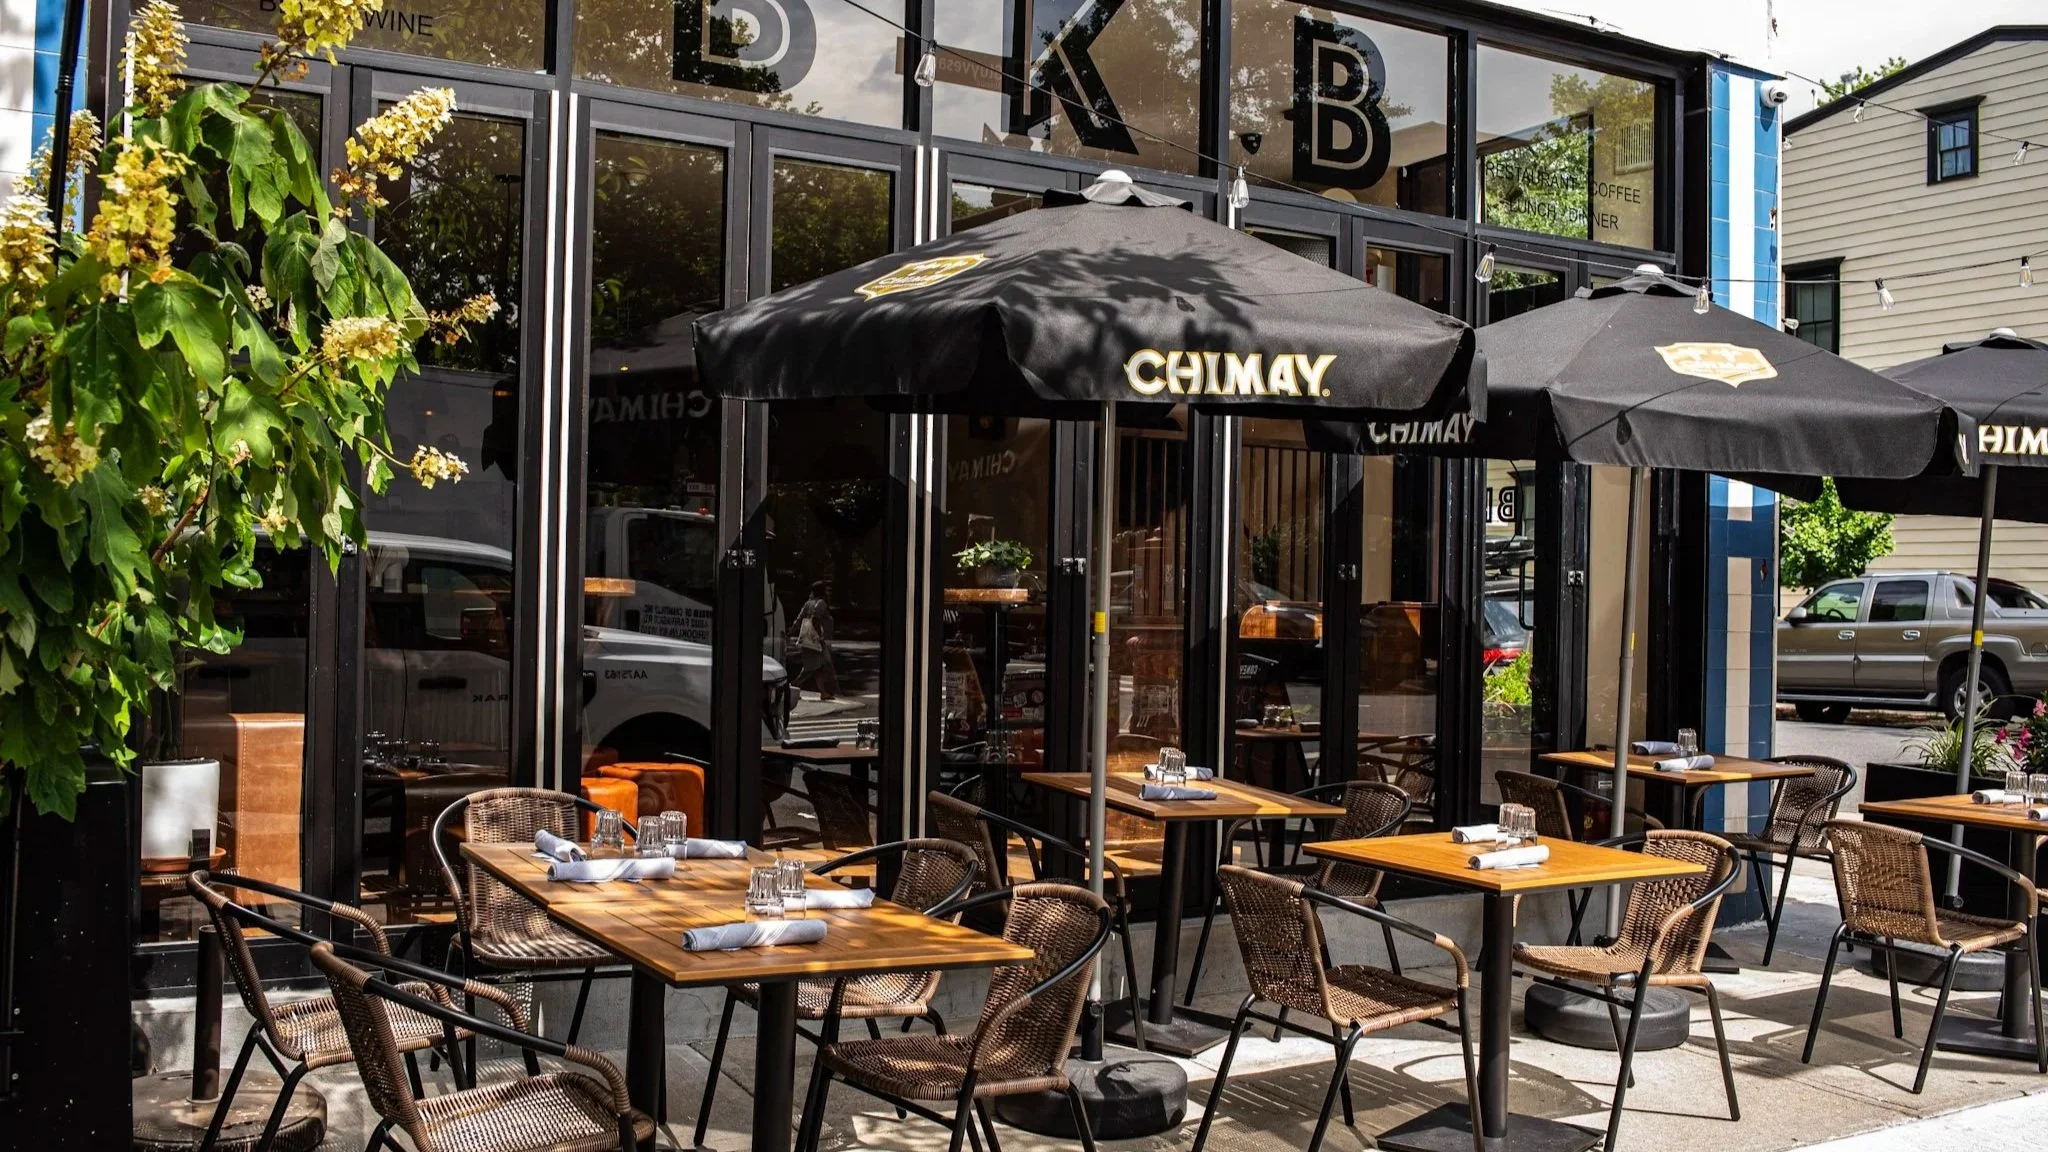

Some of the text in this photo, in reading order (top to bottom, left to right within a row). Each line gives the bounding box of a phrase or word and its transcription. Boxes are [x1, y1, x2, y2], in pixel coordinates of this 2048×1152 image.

[364, 9, 434, 37] WINE
[1292, 15, 1392, 190] B
[1485, 161, 1641, 205] RESTAURANT COFFEE
[1509, 200, 1619, 230] LUNCH DINNER
[1367, 412, 1475, 445] CHIMAY
[1978, 424, 2048, 455] HIM
